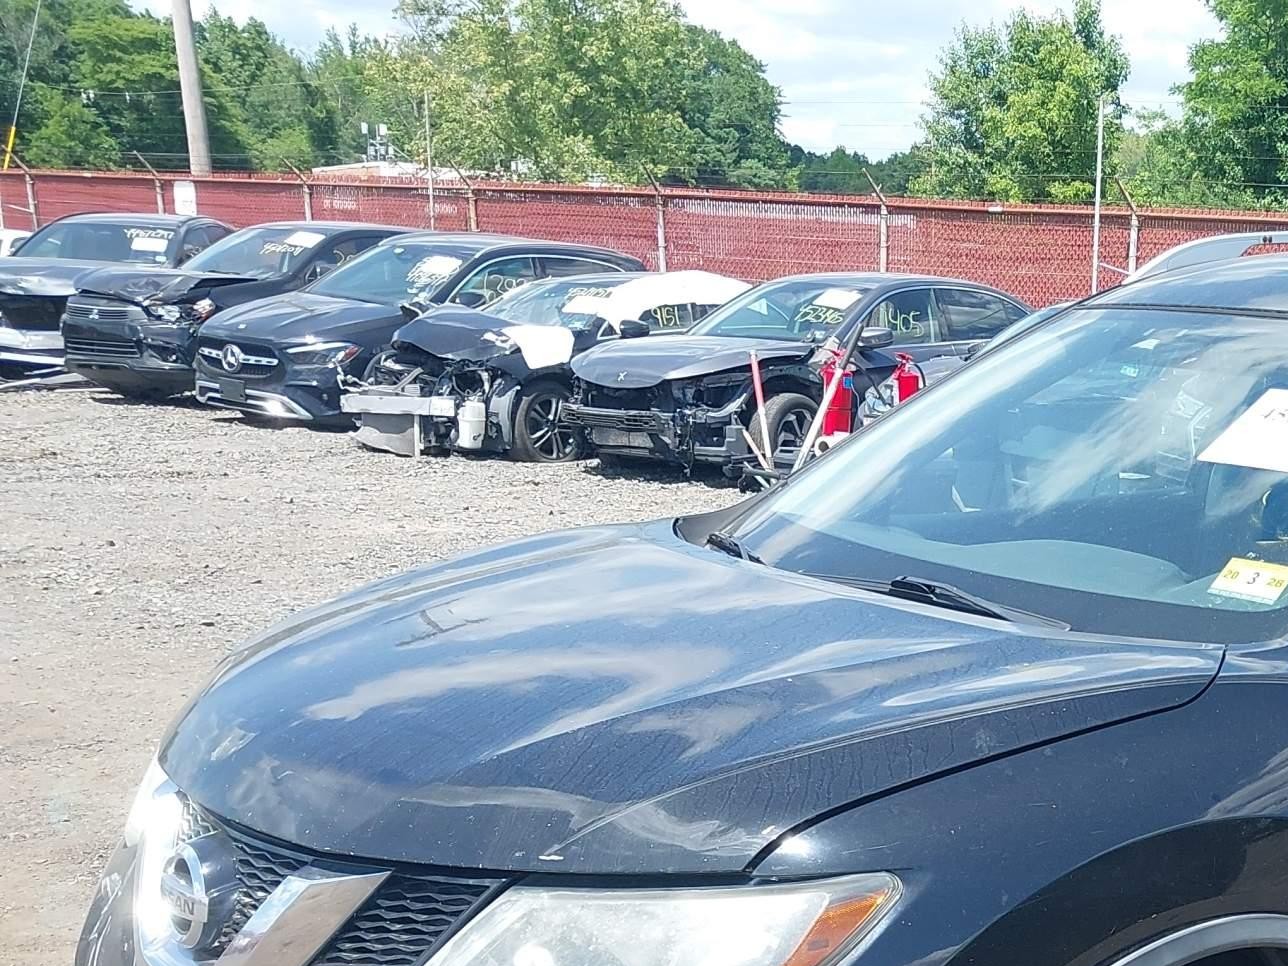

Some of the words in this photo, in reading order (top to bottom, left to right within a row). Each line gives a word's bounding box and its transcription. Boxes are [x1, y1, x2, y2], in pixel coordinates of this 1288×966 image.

[651, 306, 680, 327] 9151
[1223, 569, 1240, 580] 20
[1246, 572, 1261, 585] 3
